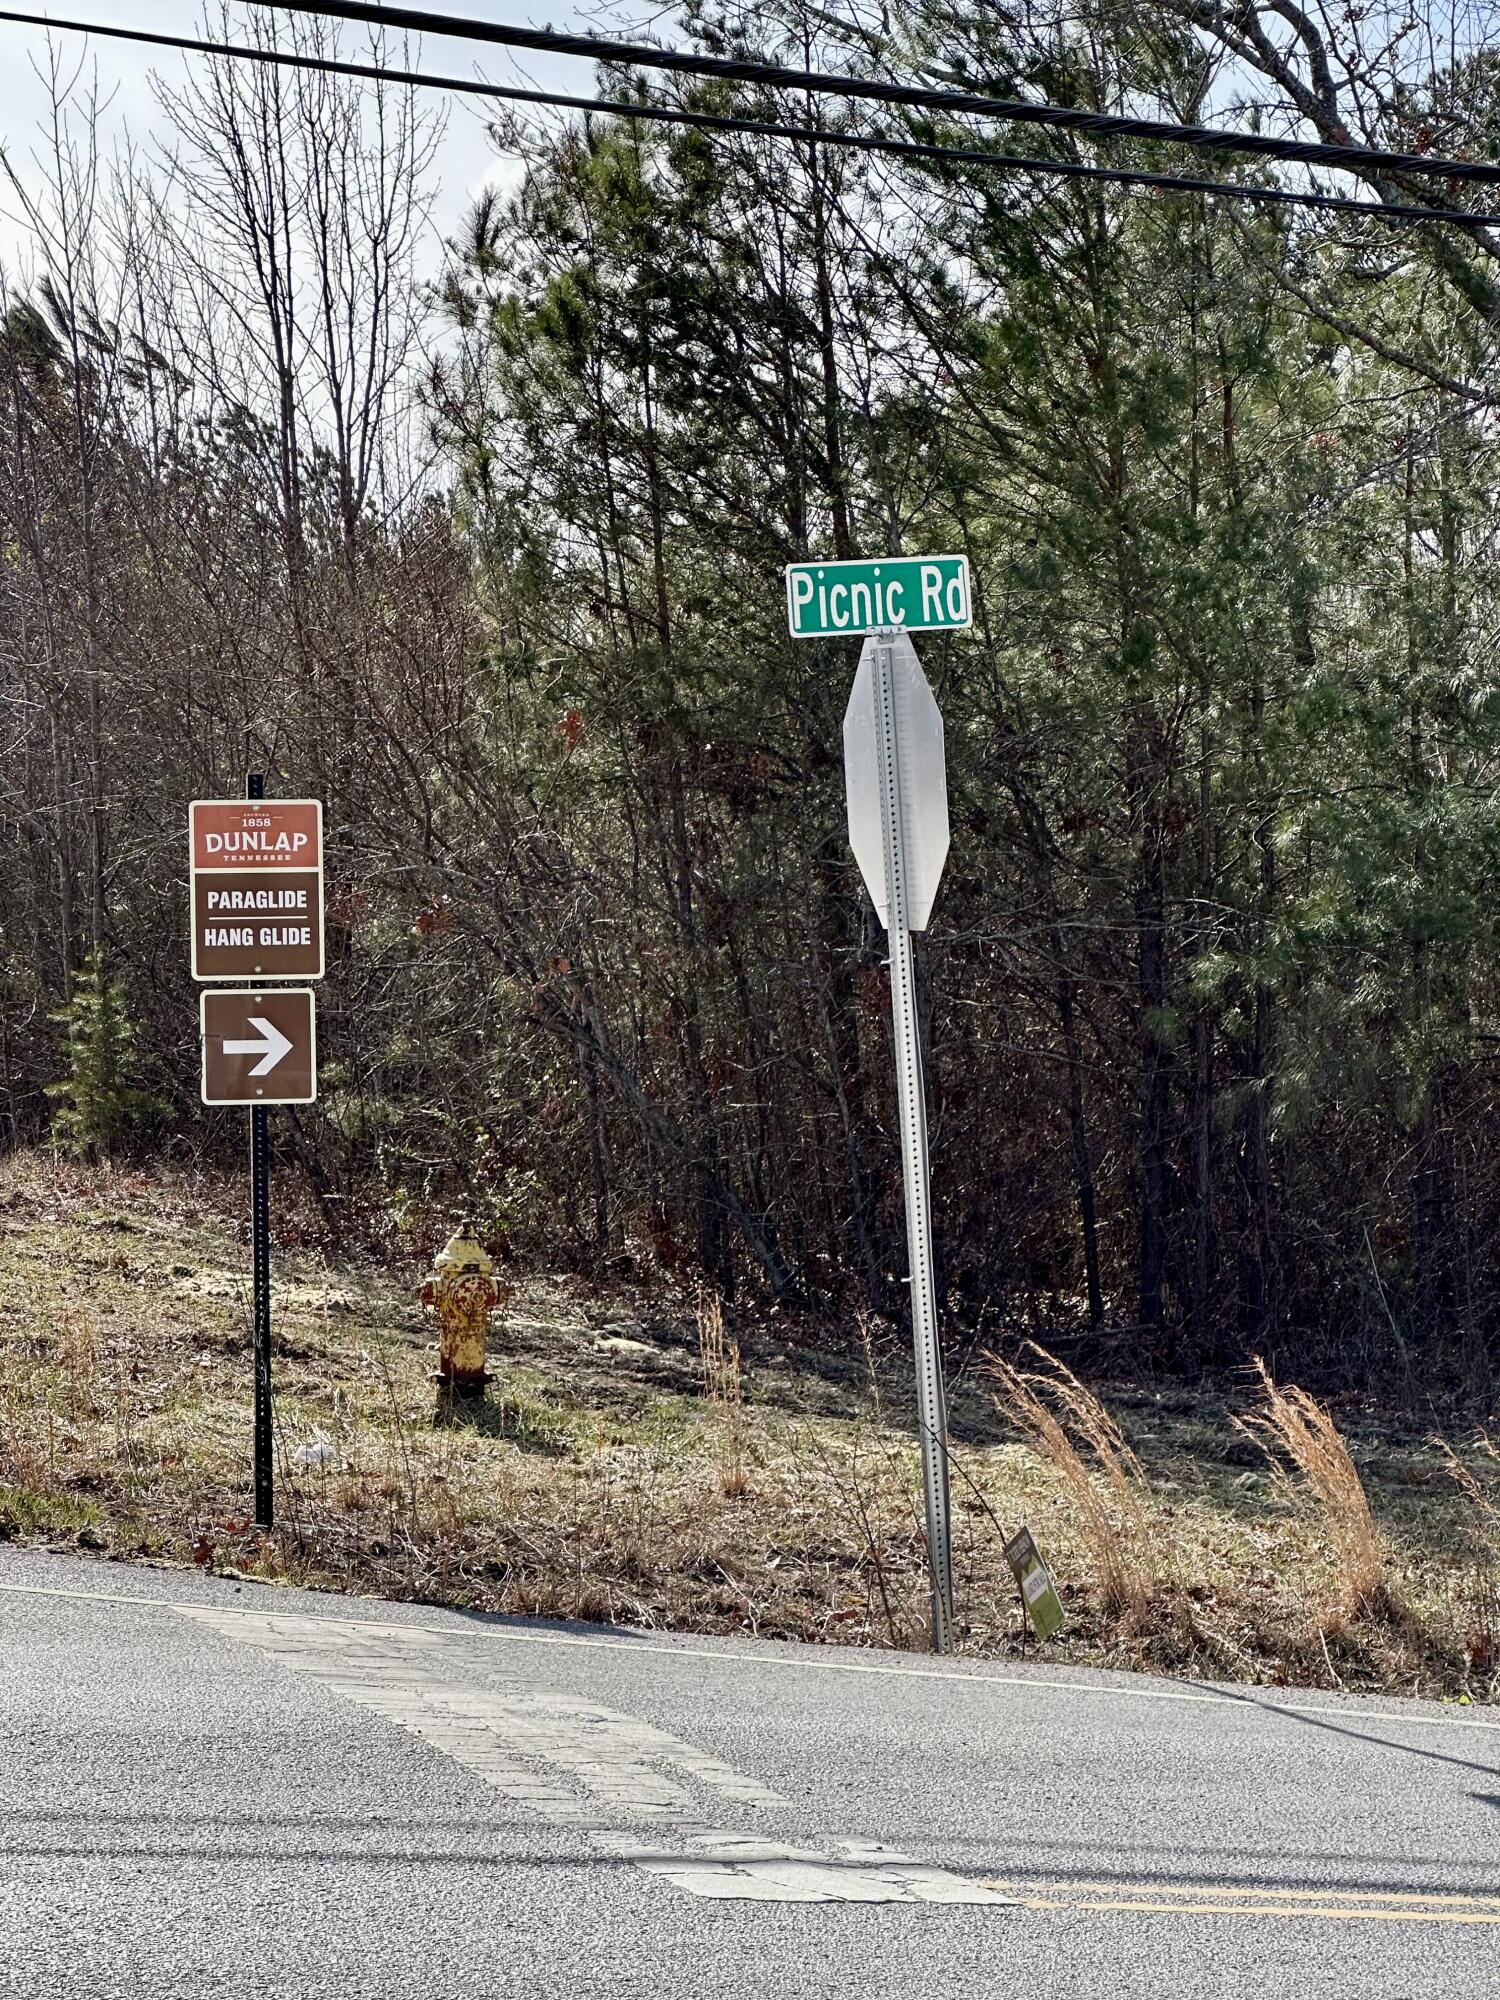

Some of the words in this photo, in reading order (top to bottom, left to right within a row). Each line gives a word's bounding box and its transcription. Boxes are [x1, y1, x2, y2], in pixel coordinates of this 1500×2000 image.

[791, 567, 905, 629] Picnic
[920, 564, 967, 622] Rd
[242, 818, 271, 827] 1858
[205, 832, 307, 852] DUNLAP
[207, 891, 307, 909] PARAGLIDE
[204, 929, 253, 946] HANG
[259, 928, 311, 945] GLIDE
